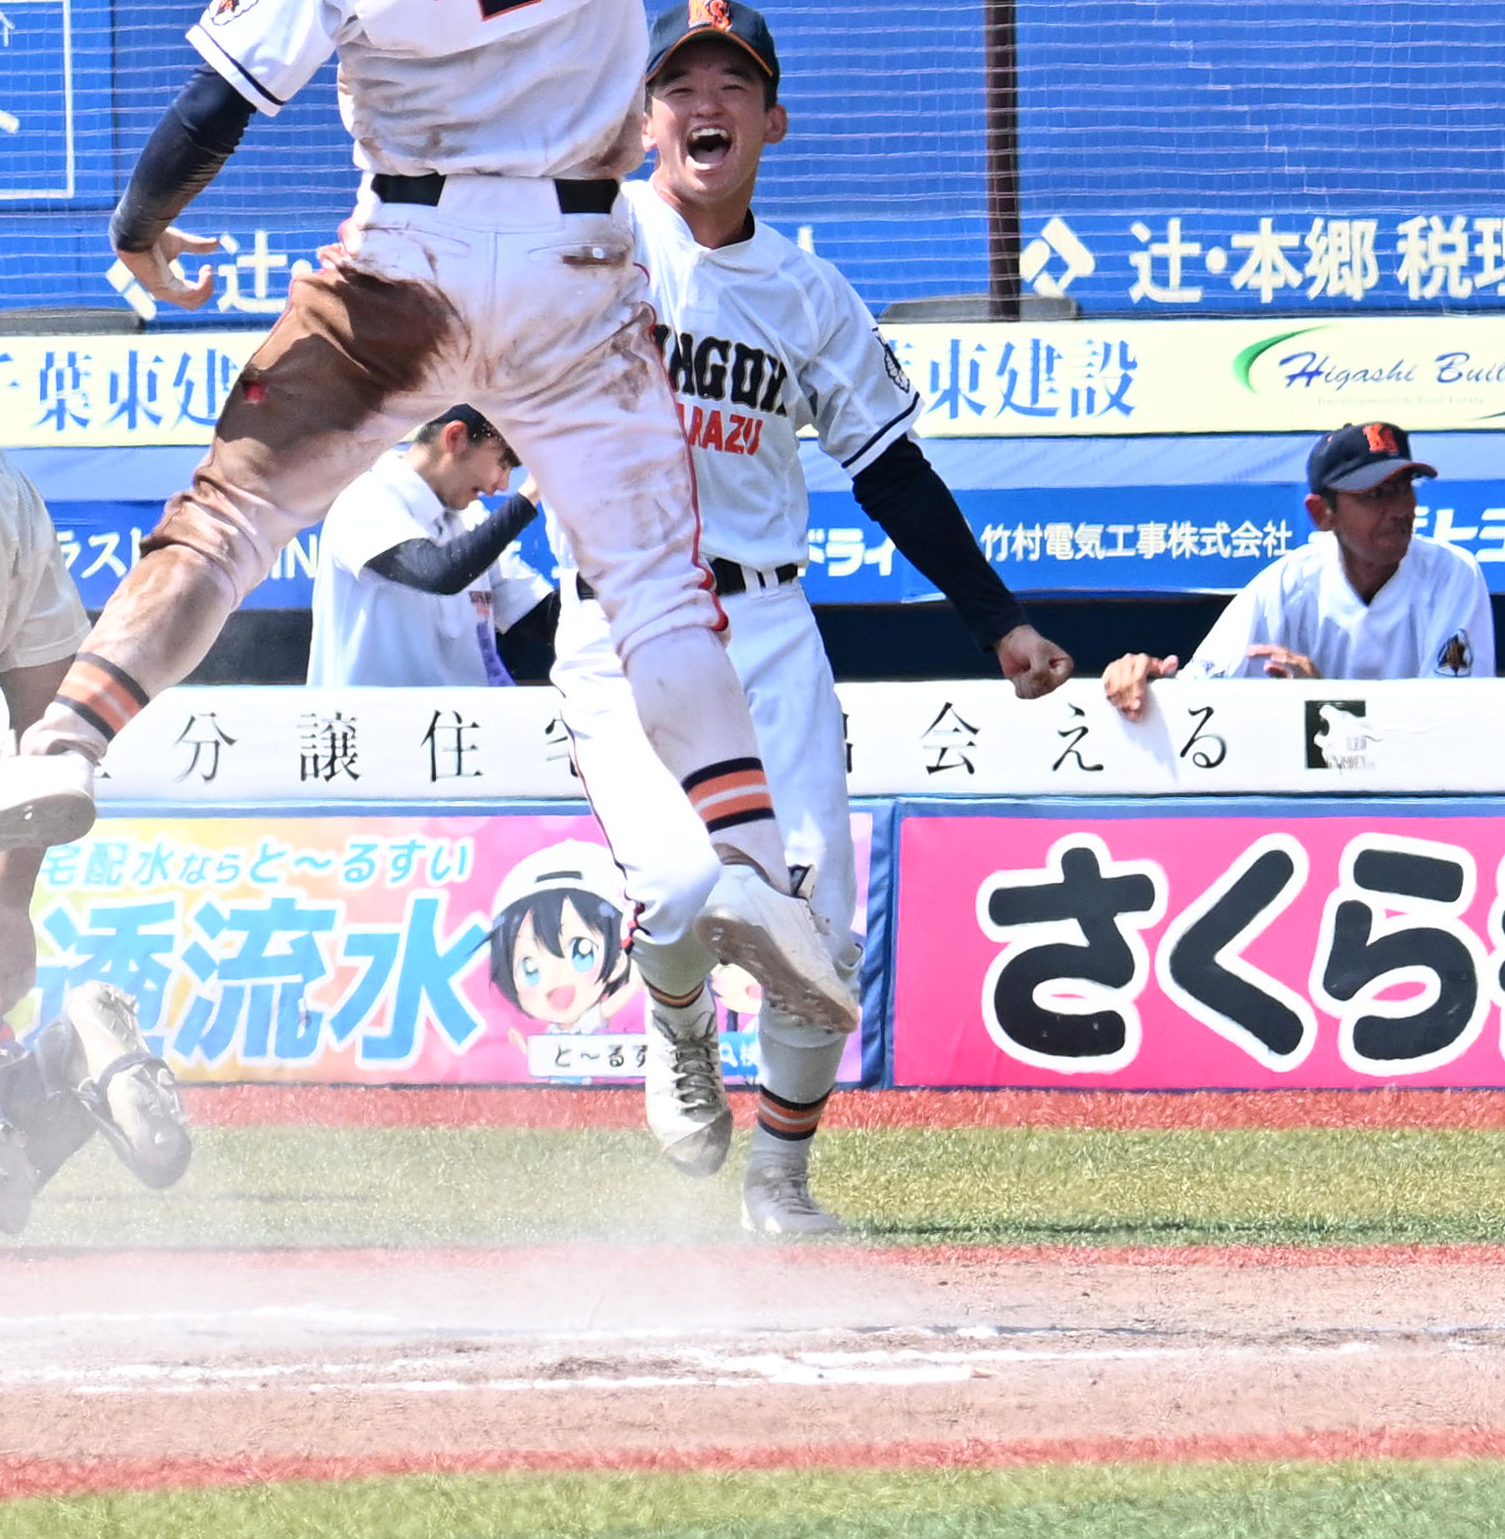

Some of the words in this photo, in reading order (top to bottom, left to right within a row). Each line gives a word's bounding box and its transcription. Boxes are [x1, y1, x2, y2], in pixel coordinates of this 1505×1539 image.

[1130, 217, 1376, 303] 辻・本郷
[1278, 350, 1416, 392] Higashi
[1435, 351, 1505, 384] Buil
[981, 520, 1293, 563] 竹村電気工事株式会社
